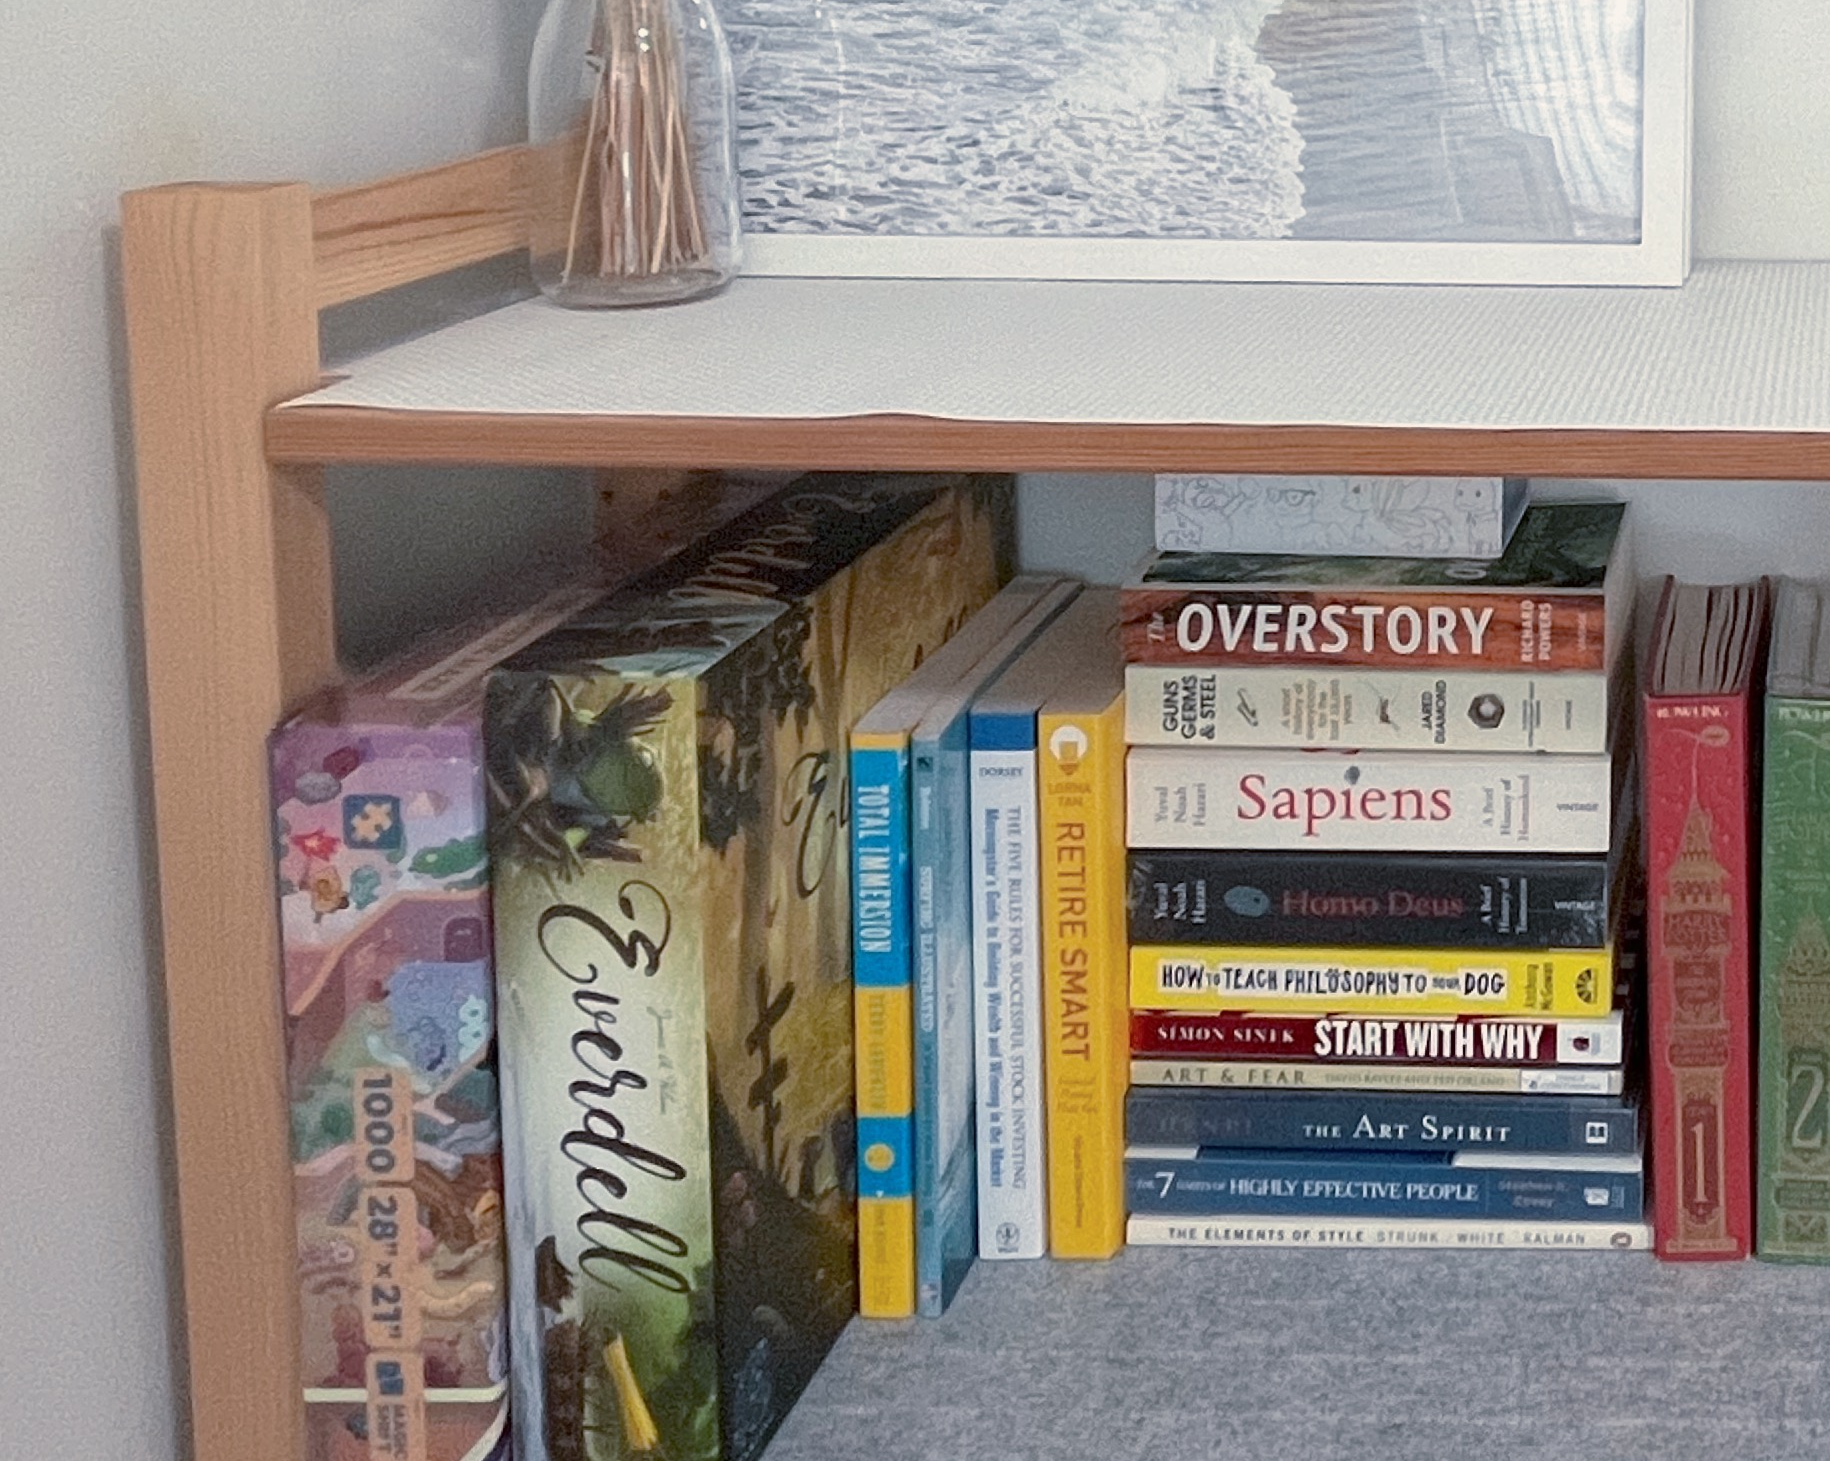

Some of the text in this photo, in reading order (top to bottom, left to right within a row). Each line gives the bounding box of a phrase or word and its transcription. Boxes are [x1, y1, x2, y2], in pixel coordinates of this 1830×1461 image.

[1176, 602, 1494, 655] OVERSTORY
[1520, 600, 1535, 662] RICHARD
[1538, 602, 1553, 661] POWERS
[1162, 680, 1179, 732] GUNS
[1181, 675, 1198, 740] GERMS
[1200, 674, 1216, 740] & STEEL
[1421, 691, 1433, 731] JARED
[1435, 679, 1447, 745] DIAMOND
[978, 765, 1023, 777] DORSEY
[1154, 786, 1169, 823] Yuval
[1173, 786, 1187, 823] Noah
[1192, 782, 1206, 827] Harari
[1237, 769, 1452, 837] Sapiens
[857, 784, 892, 953] TOTAL IMMERSION
[1056, 822, 1088, 939] RETIRE
[1282, 889, 1465, 918] Homo Deus
[1554, 900, 1597, 911] VINTAGE
[1007, 806, 1027, 1190] THE FIVE RULES FOR SUCCESSFUL STOCK INVESTING
[1059, 949, 1090, 1062] SMART
[1162, 964, 1204, 991] HOW
[1222, 967, 1278, 991] TEACH
[1401, 973, 1428, 993] TO
[1463, 972, 1505, 996] DOG
[1157, 1024, 1295, 1043] SIMON SINEK
[1313, 1019, 1544, 1060] START WITH WHY
[537, 879, 691, 1294] Everdell
[1162, 1067, 1306, 1084] ART & FEAR
[362, 1072, 395, 1173] 1000
[1303, 1124, 1342, 1138] THE
[1420, 1114, 1511, 1142] SPIRIT
[1791, 1065, 1825, 1148] 2
[1155, 1171, 1175, 1199] 7
[1229, 1178, 1298, 1196] HIGHLY
[1303, 1180, 1401, 1199] EFFECTIVE
[1406, 1184, 1479, 1202] PEOPLE
[1690, 1122, 1709, 1203] 1
[1168, 1227, 1586, 1245] THE ELEMENTS OF STYLE STRUNK WHITE KALMAN
[376, 1262, 393, 1278] x
